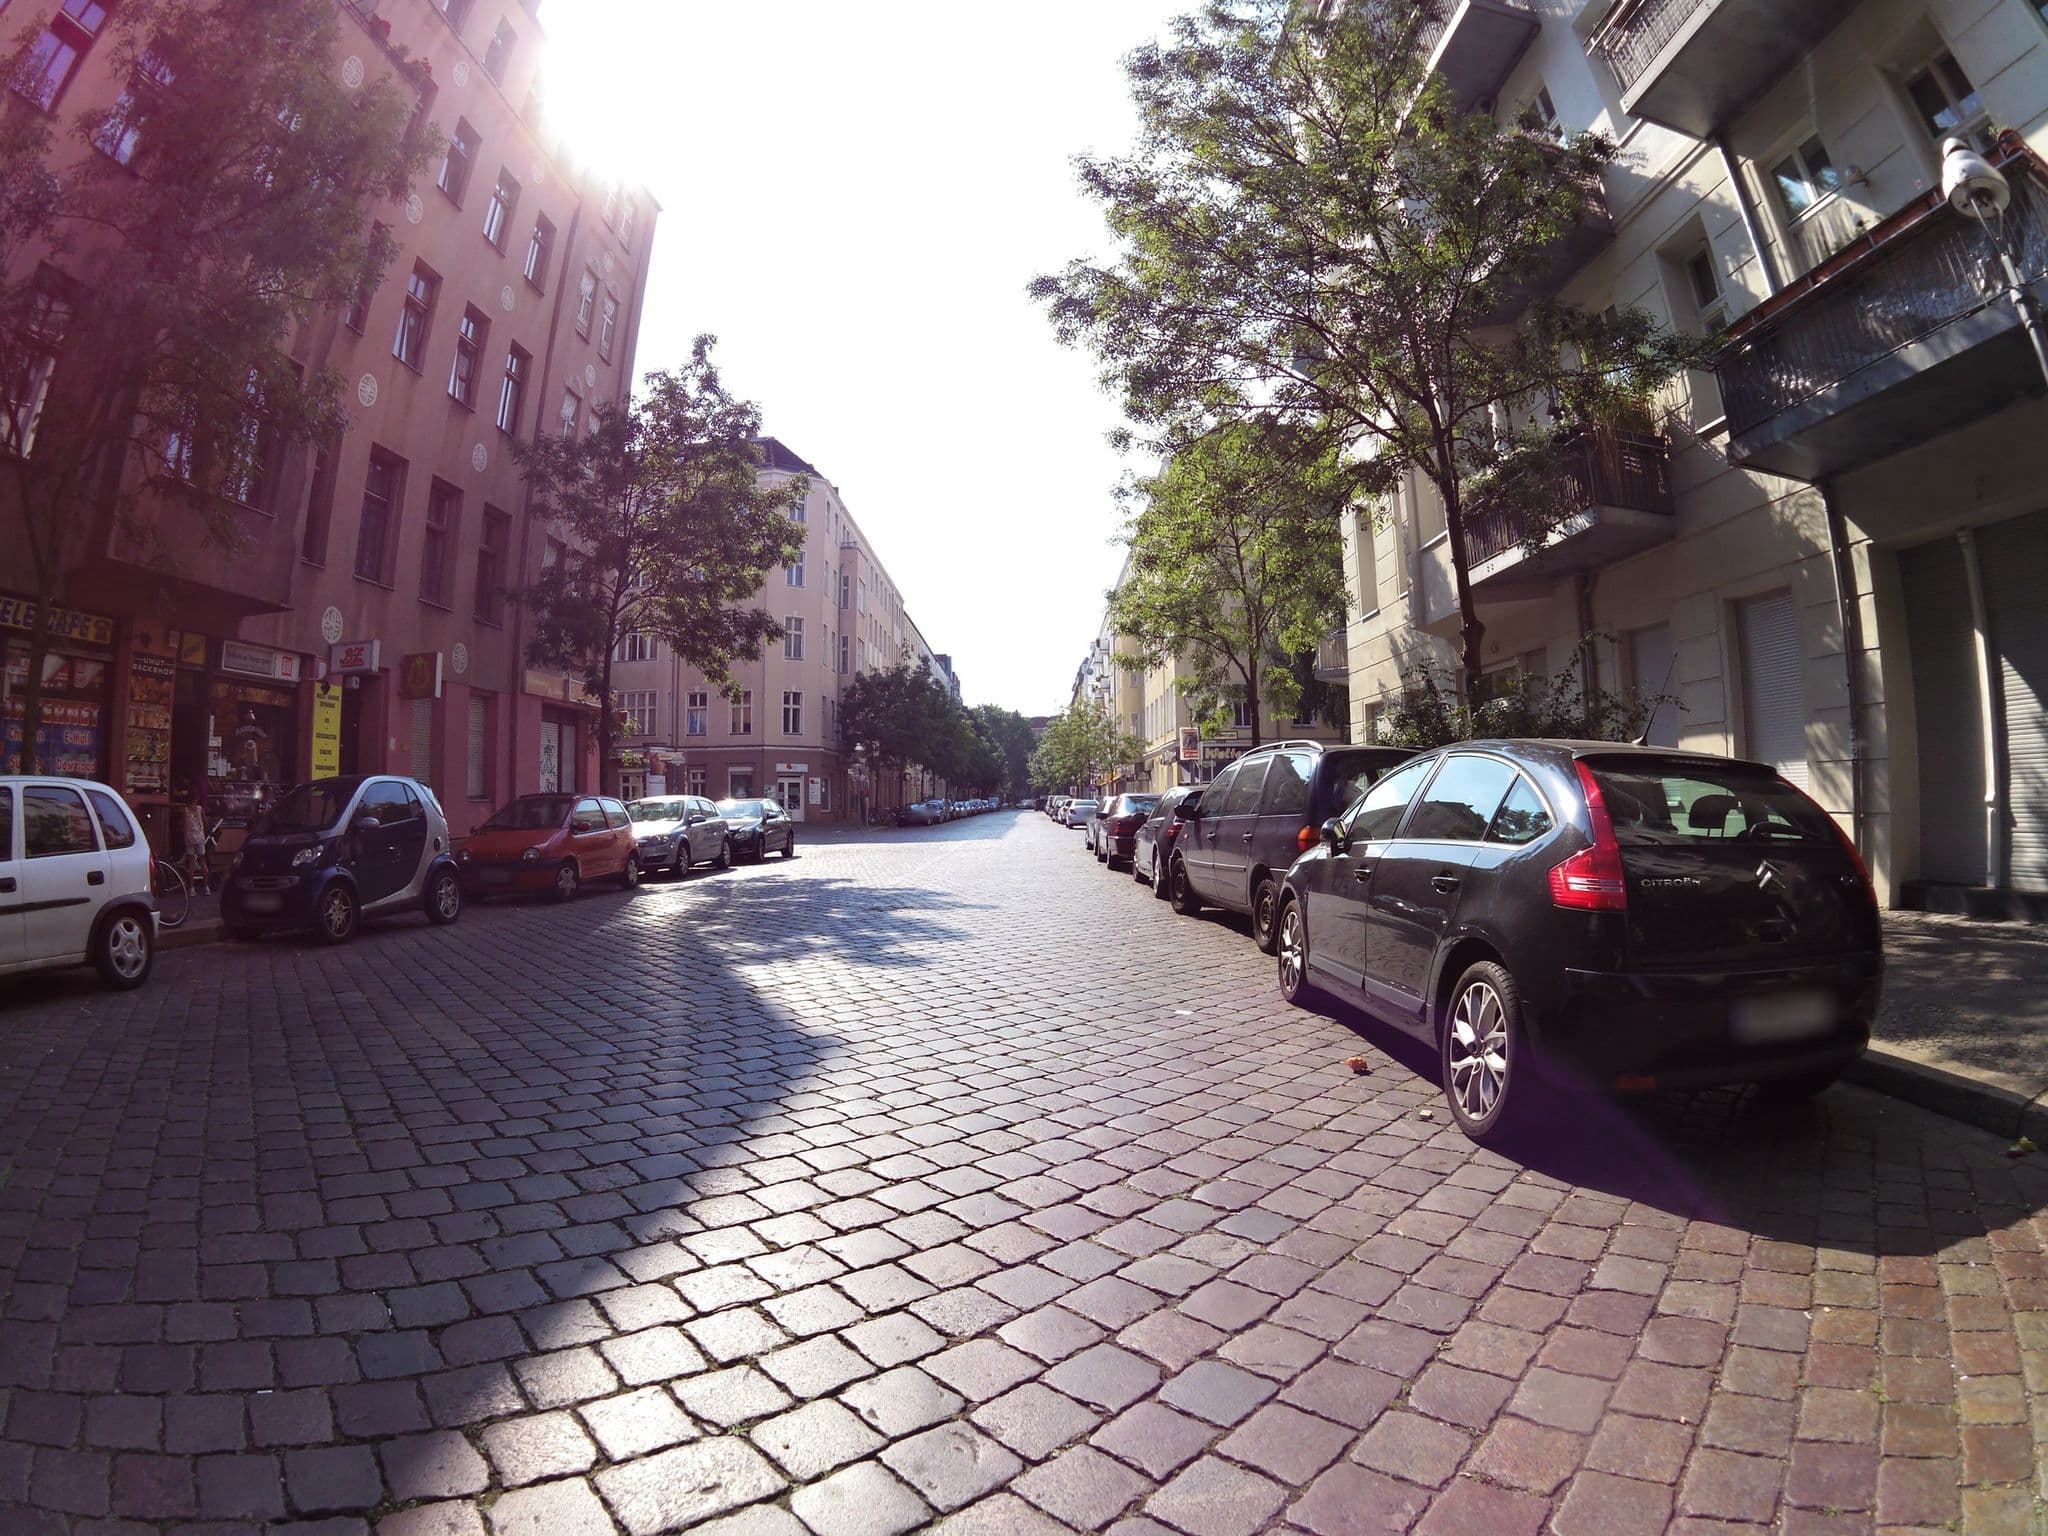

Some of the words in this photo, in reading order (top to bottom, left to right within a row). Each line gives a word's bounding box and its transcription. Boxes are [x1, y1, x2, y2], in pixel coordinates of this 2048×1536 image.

[0, 599, 36, 629] ELE
[143, 655, 165, 667] UMUT
[1640, 876, 1700, 888] CITROËN
